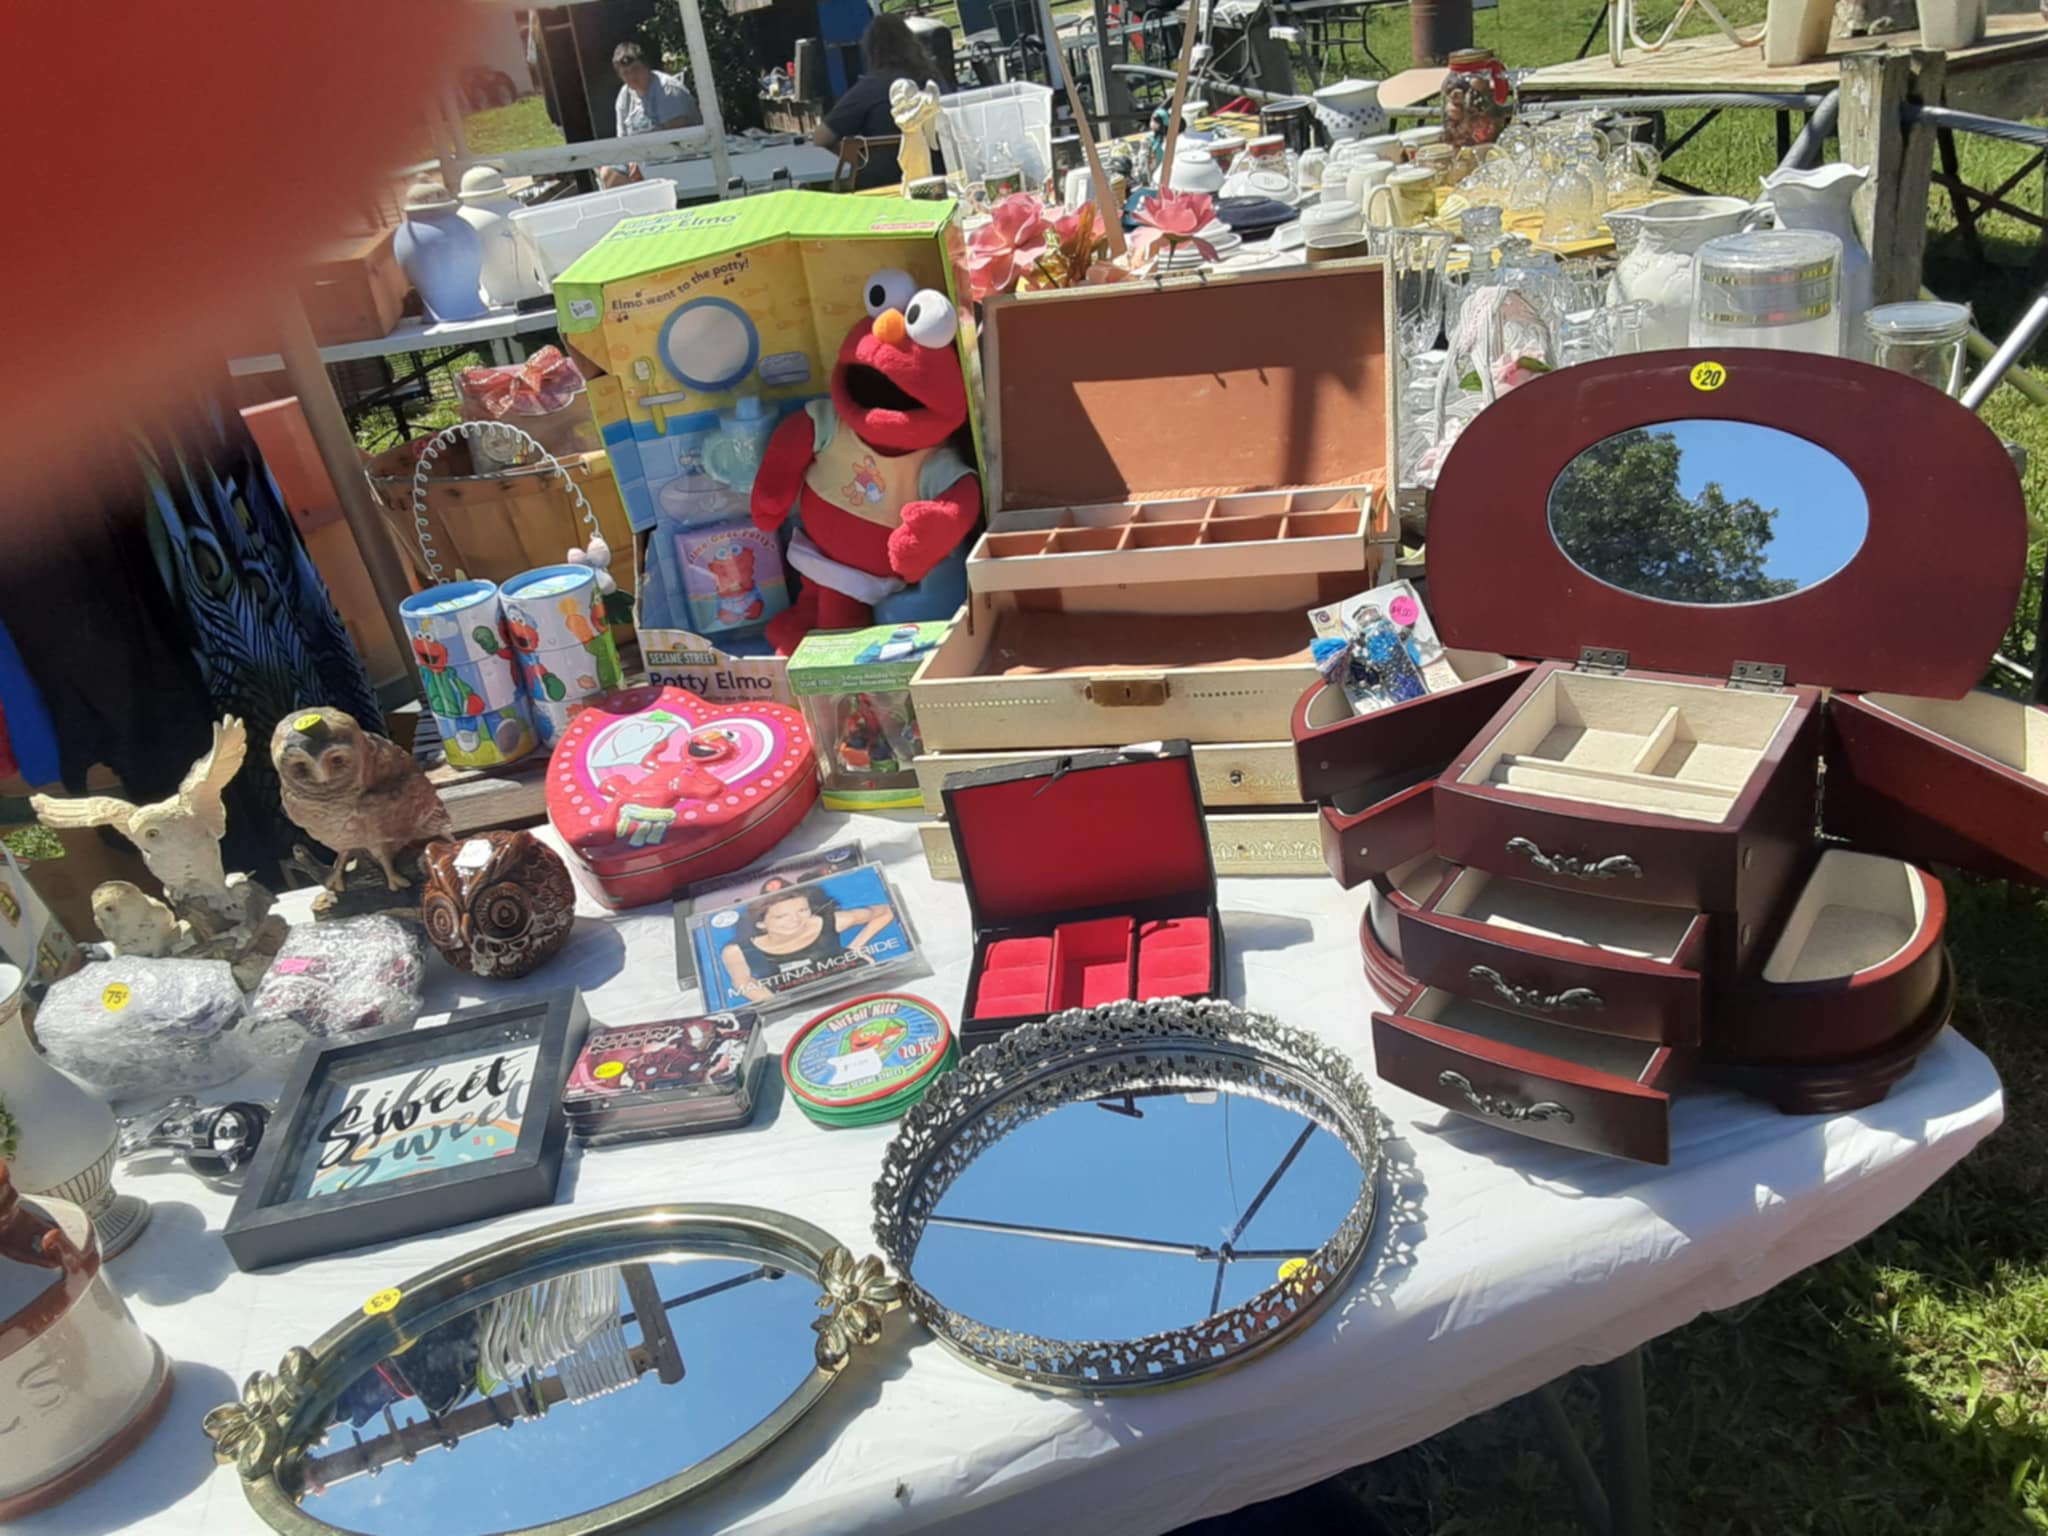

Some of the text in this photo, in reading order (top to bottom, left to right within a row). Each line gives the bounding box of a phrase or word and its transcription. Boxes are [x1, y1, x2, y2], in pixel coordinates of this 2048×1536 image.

[611, 257, 750, 310] Elmo went to the potty!
[1695, 368, 1722, 387] $20
[648, 650, 717, 665] SESAME STREET
[649, 670, 773, 695] Potty Elmo
[727, 966, 815, 999] MARTINA
